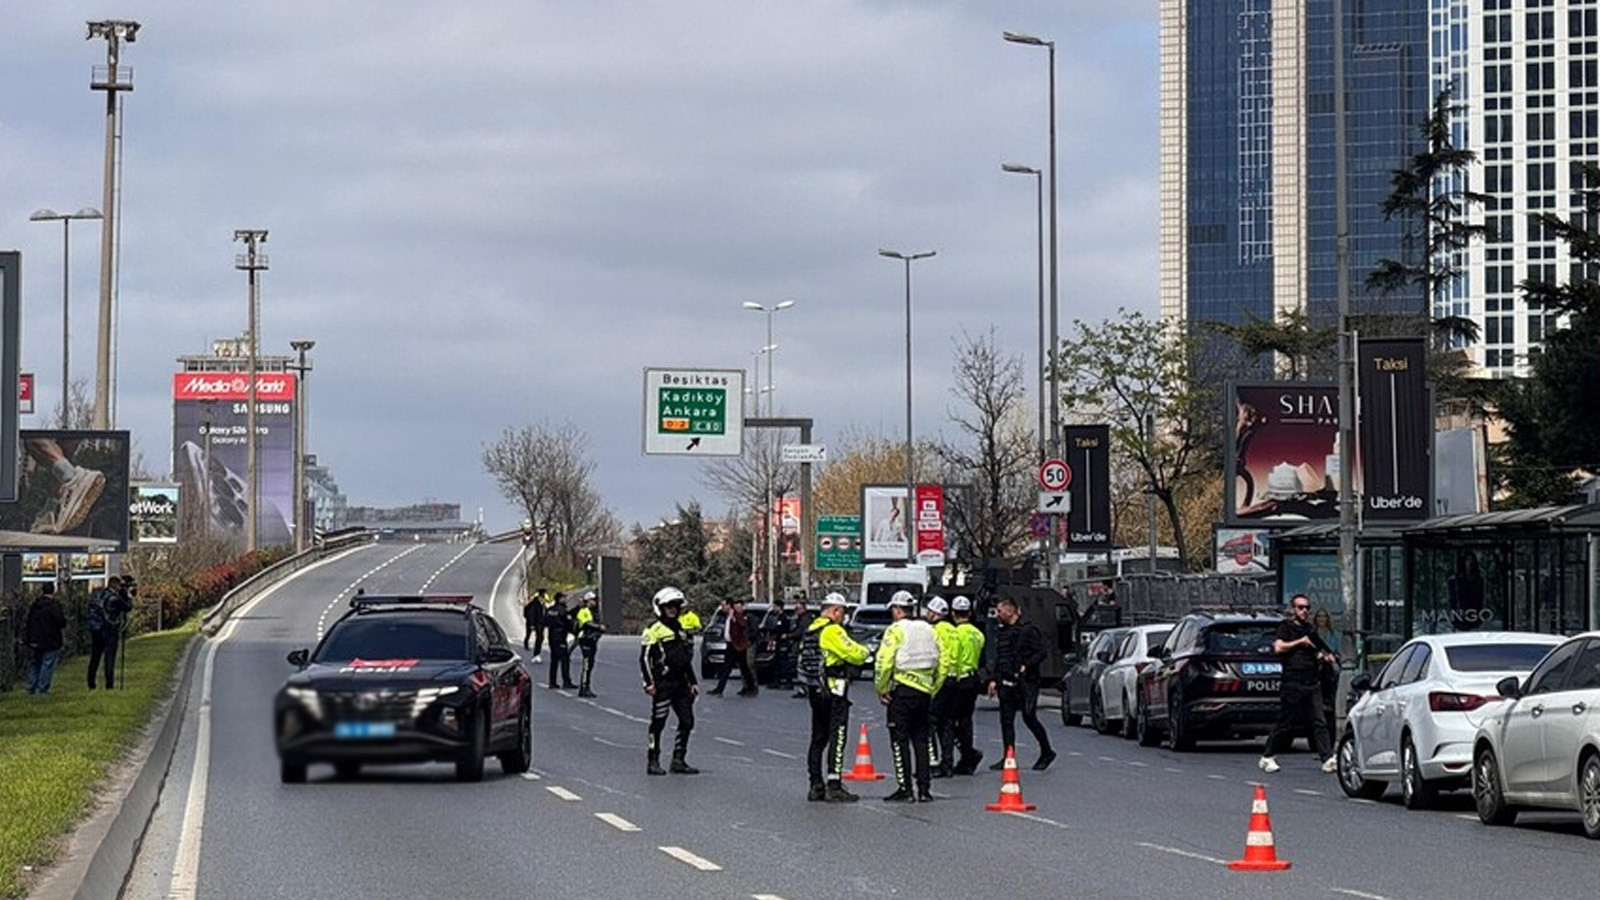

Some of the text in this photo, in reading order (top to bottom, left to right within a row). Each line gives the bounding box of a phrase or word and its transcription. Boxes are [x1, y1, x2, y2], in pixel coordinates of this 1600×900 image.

[1373, 357, 1408, 371] Taksi
[183, 377, 231, 393] Media
[661, 390, 723, 405] Kadıköy
[233, 403, 290, 414] SASUNG
[662, 406, 717, 417] Ankara
[1046, 468, 1064, 483] 50
[129, 501, 174, 514] etWork
[1370, 496, 1423, 509] Uber'de
[1071, 532, 1107, 542] Uber'de
[1421, 609, 1494, 622] MANGO
